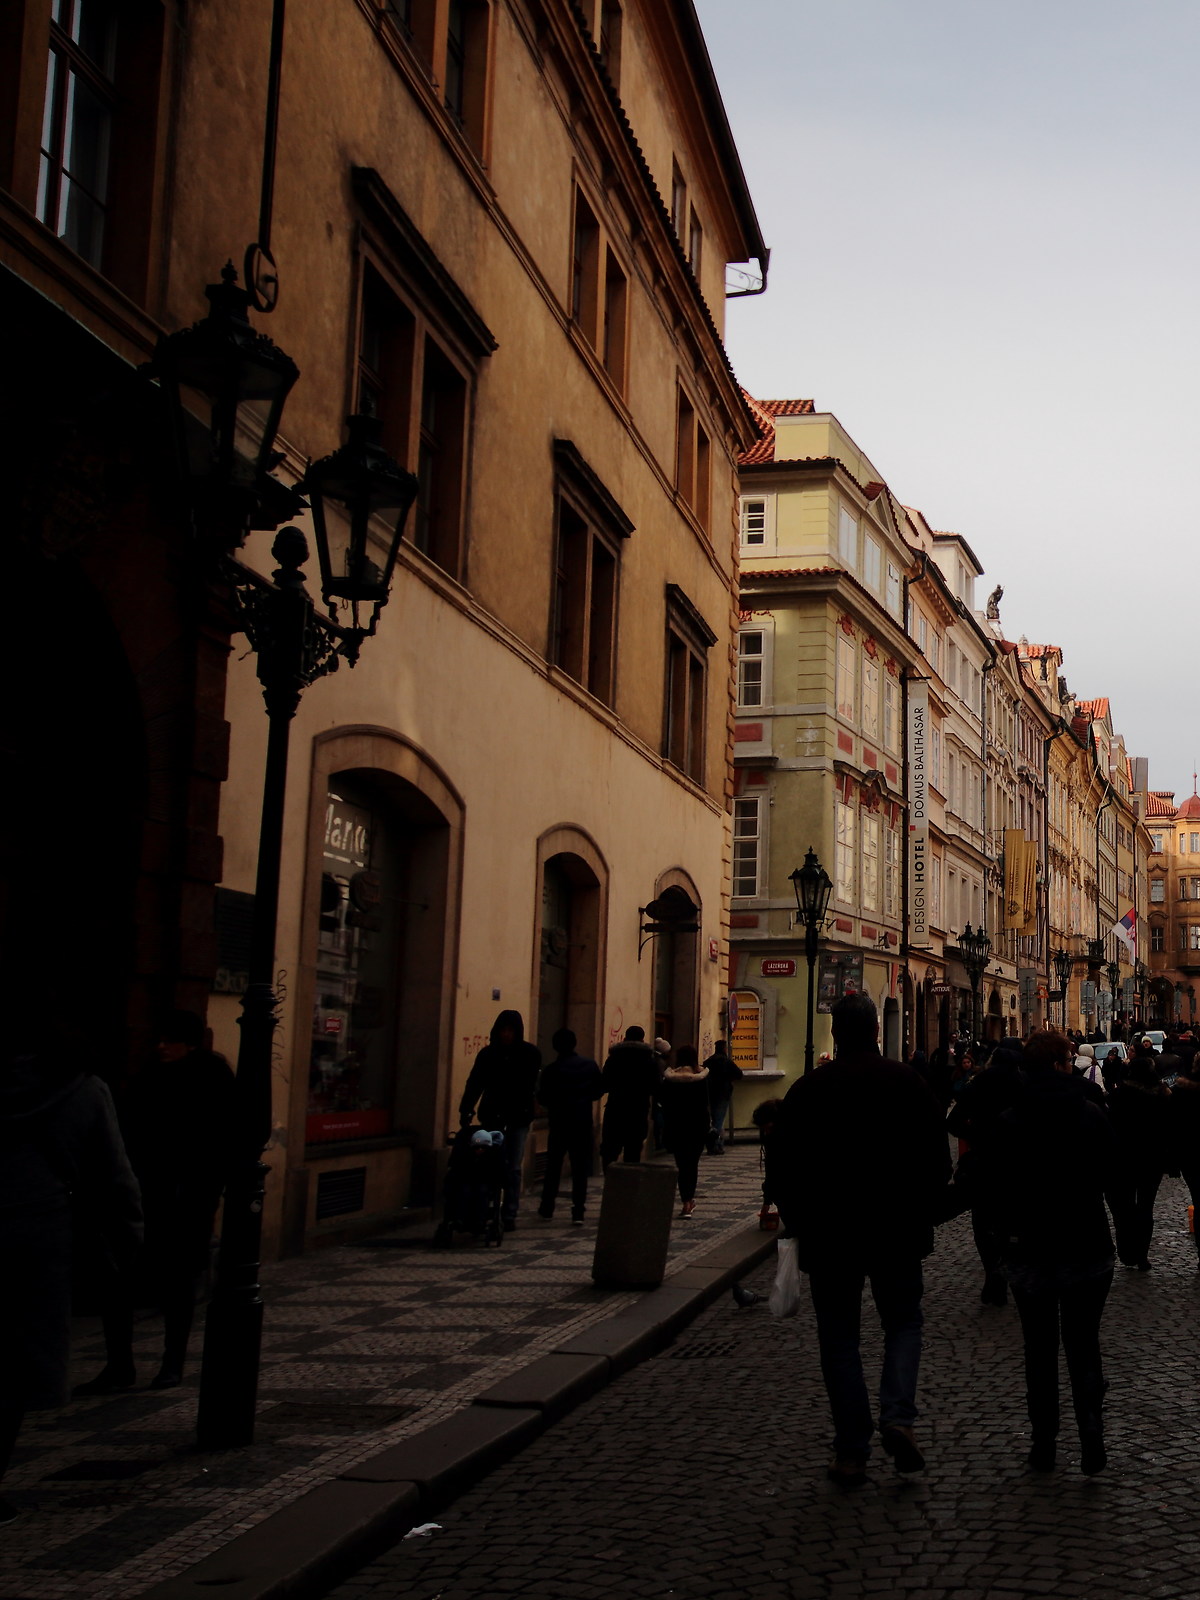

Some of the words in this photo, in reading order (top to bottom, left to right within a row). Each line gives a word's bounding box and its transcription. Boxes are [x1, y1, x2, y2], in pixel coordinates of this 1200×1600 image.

[914, 706, 924, 771] BALTHASAR
[914, 774, 924, 818] DOMUS
[914, 838, 925, 882] HOTEL
[914, 887, 925, 933] DESIGN
